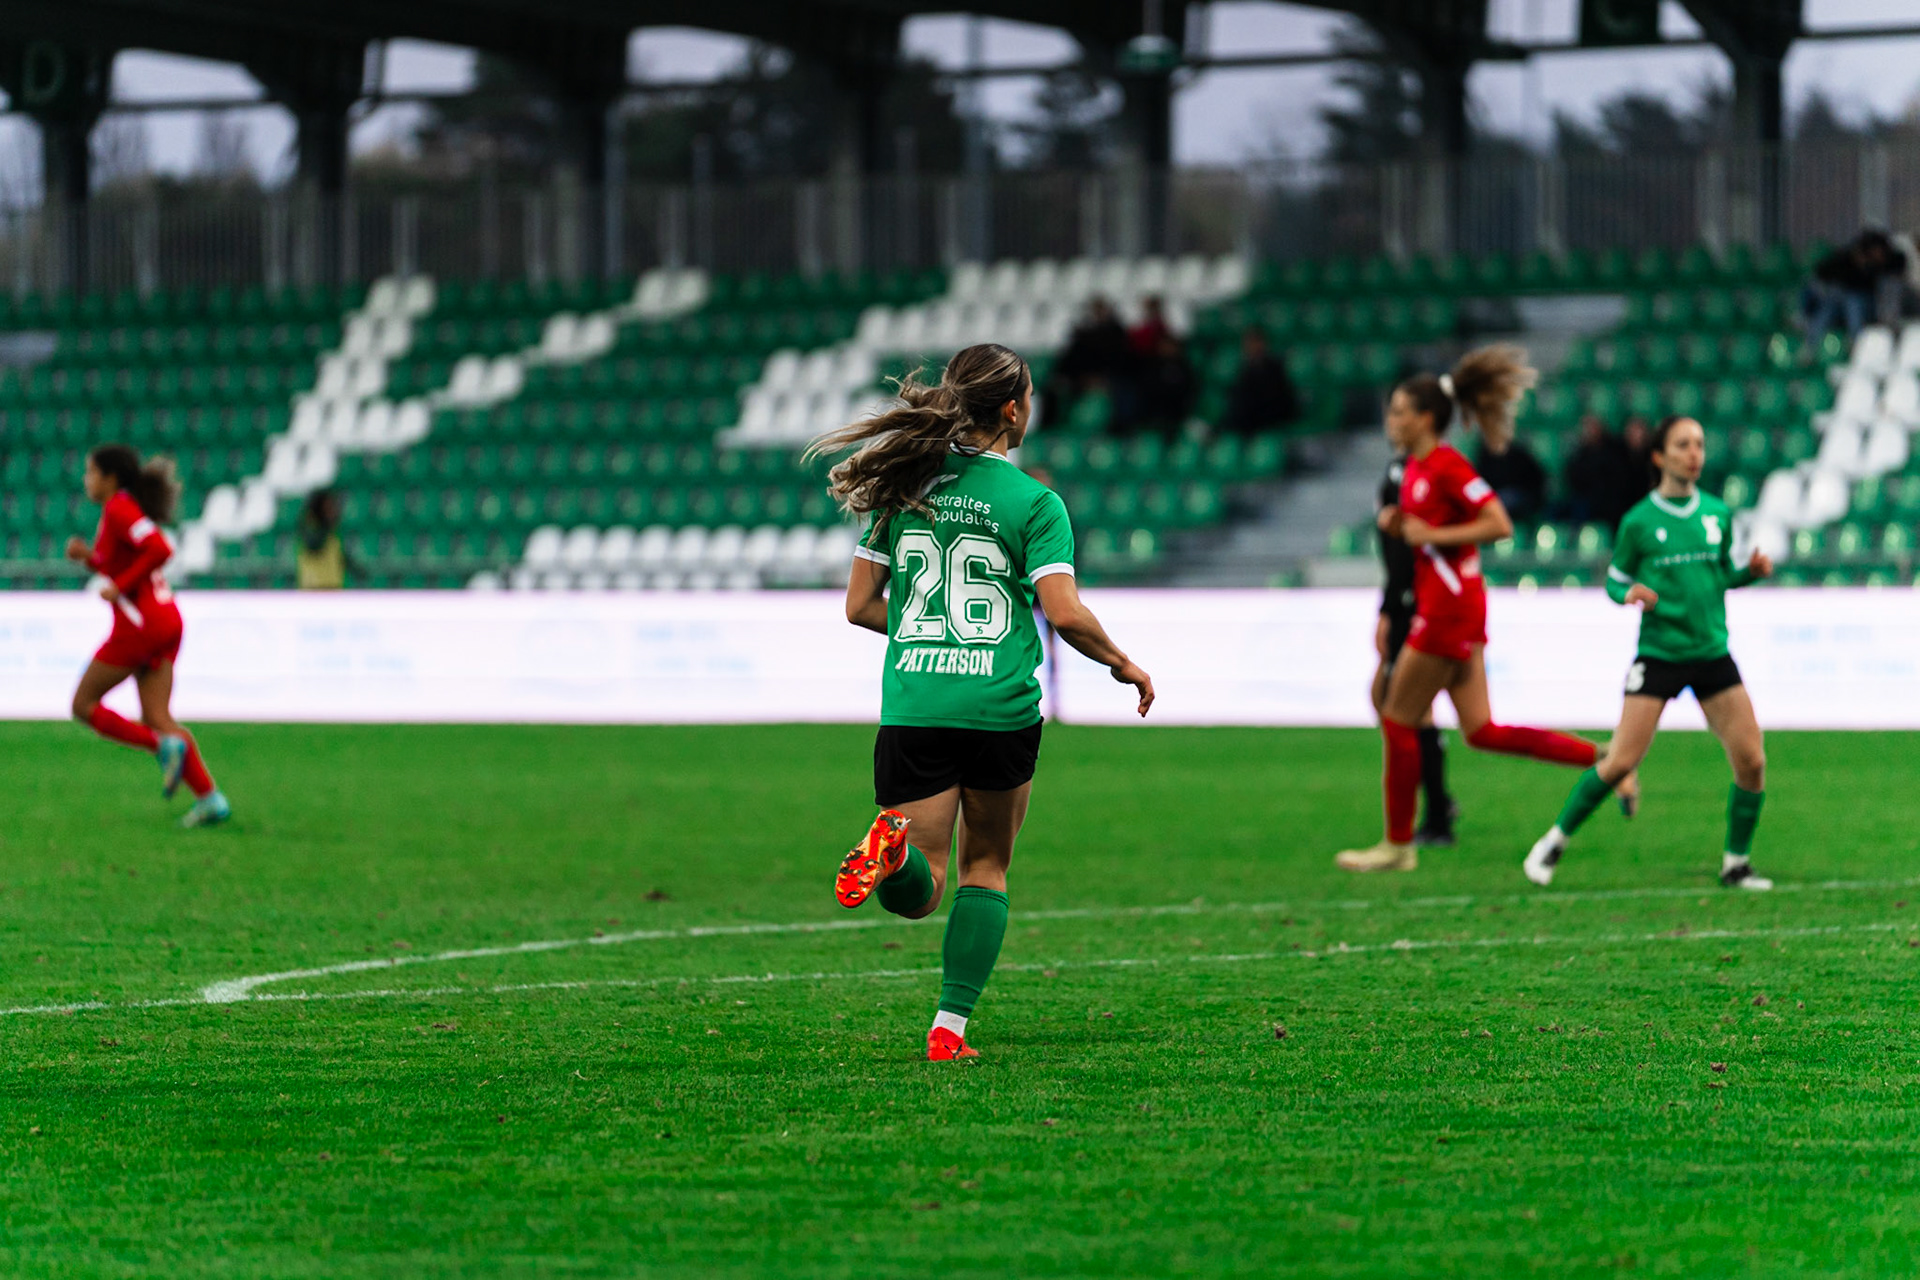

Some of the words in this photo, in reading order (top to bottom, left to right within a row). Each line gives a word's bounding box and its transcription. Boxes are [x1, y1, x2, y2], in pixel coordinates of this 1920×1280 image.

[929, 494, 991, 514] Retraites
[893, 529, 1012, 645] 26
[894, 647, 995, 677] PATTERSON
